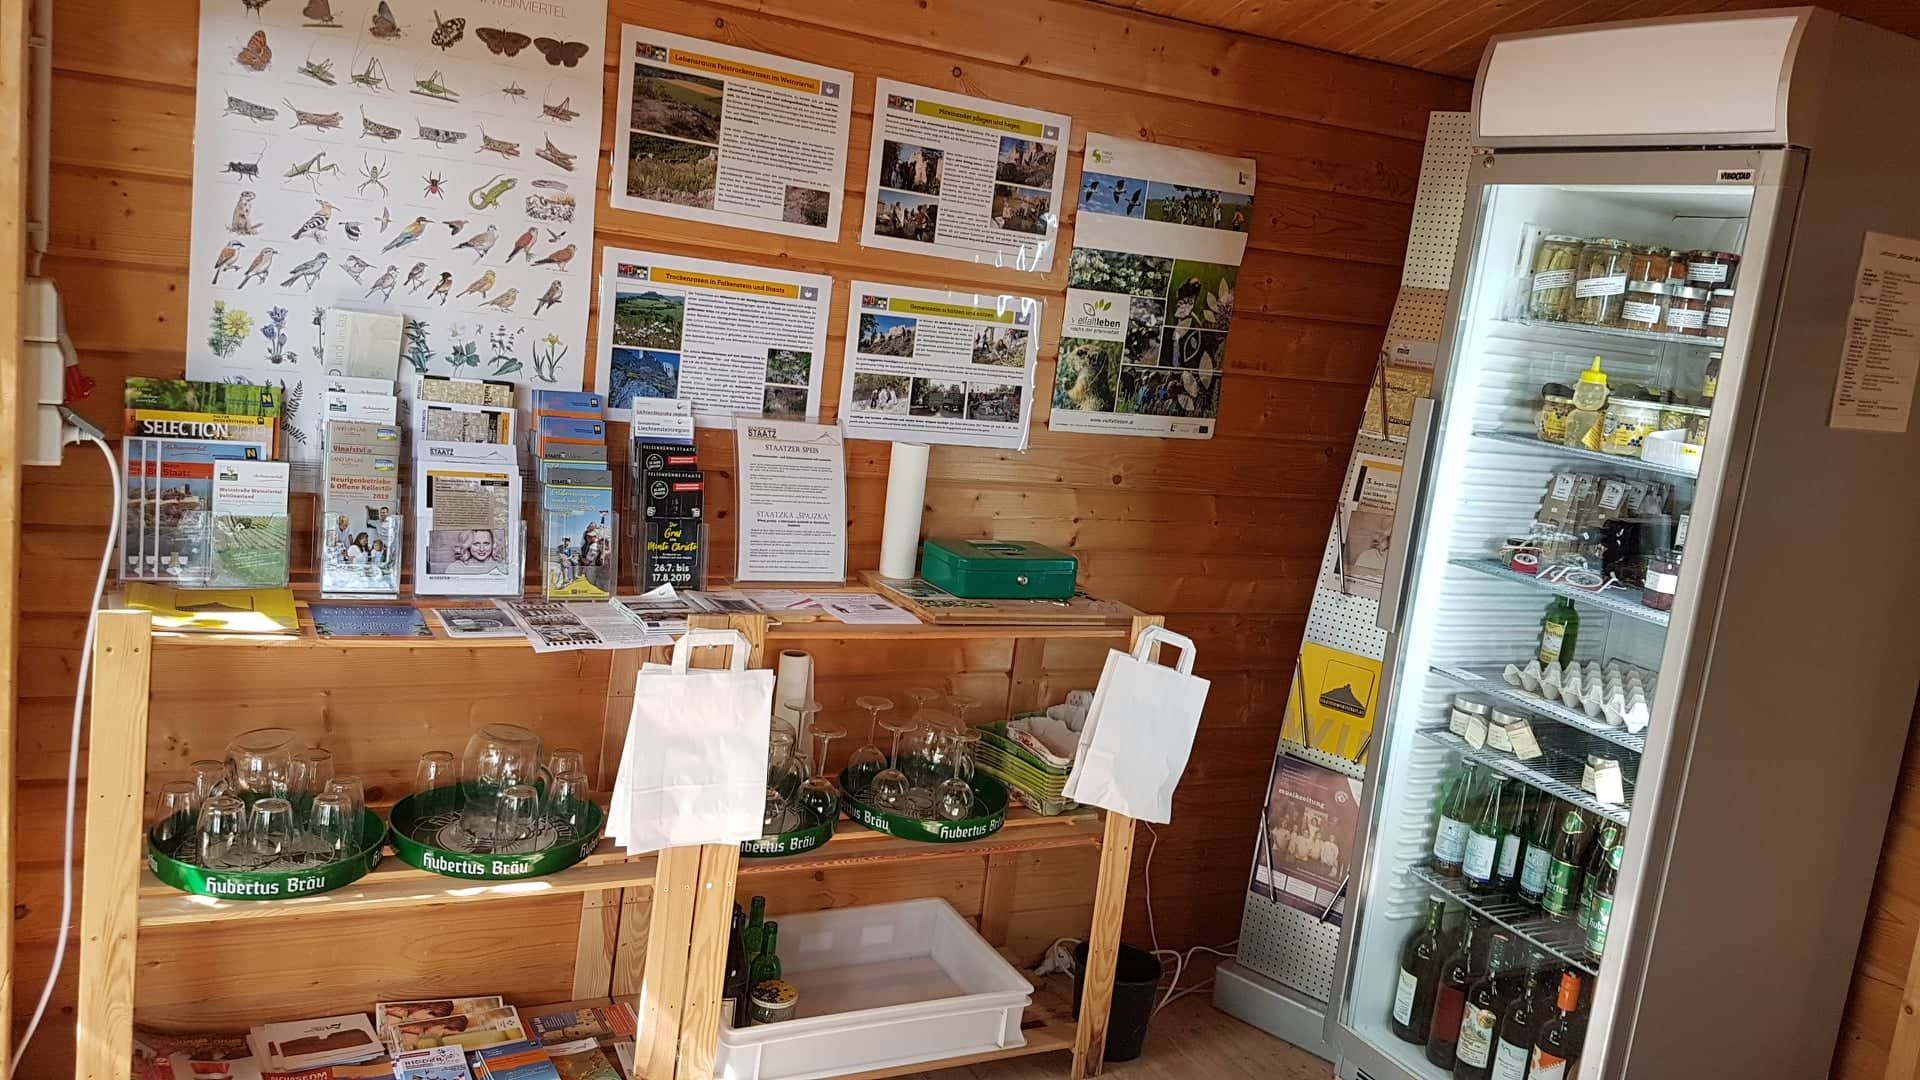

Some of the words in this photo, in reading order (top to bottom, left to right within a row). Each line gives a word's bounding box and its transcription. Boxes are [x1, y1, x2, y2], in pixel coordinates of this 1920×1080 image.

[665, 272, 710, 285] Trockenrasen
[143, 420, 230, 438] SELECTION
[748, 429, 777, 438] STAATZ
[765, 444, 801, 452] STAATZER
[802, 446, 820, 454] SPEIS
[330, 476, 392, 485] Heurigenbetriebe
[756, 511, 794, 519] STAATZKA
[653, 563, 675, 572] 26.7.
[676, 563, 690, 572] bis
[651, 573, 692, 582] 17.8.2019
[1278, 788, 1326, 809] musikzeitung
[864, 810, 890, 830] Bräu
[940, 825, 987, 840] Hubertus
[789, 835, 816, 851] Bräu
[422, 851, 485, 875] Hubertus
[491, 859, 529, 875] Bräu
[205, 876, 280, 895] Hubertus
[287, 875, 326, 893] Bräu
